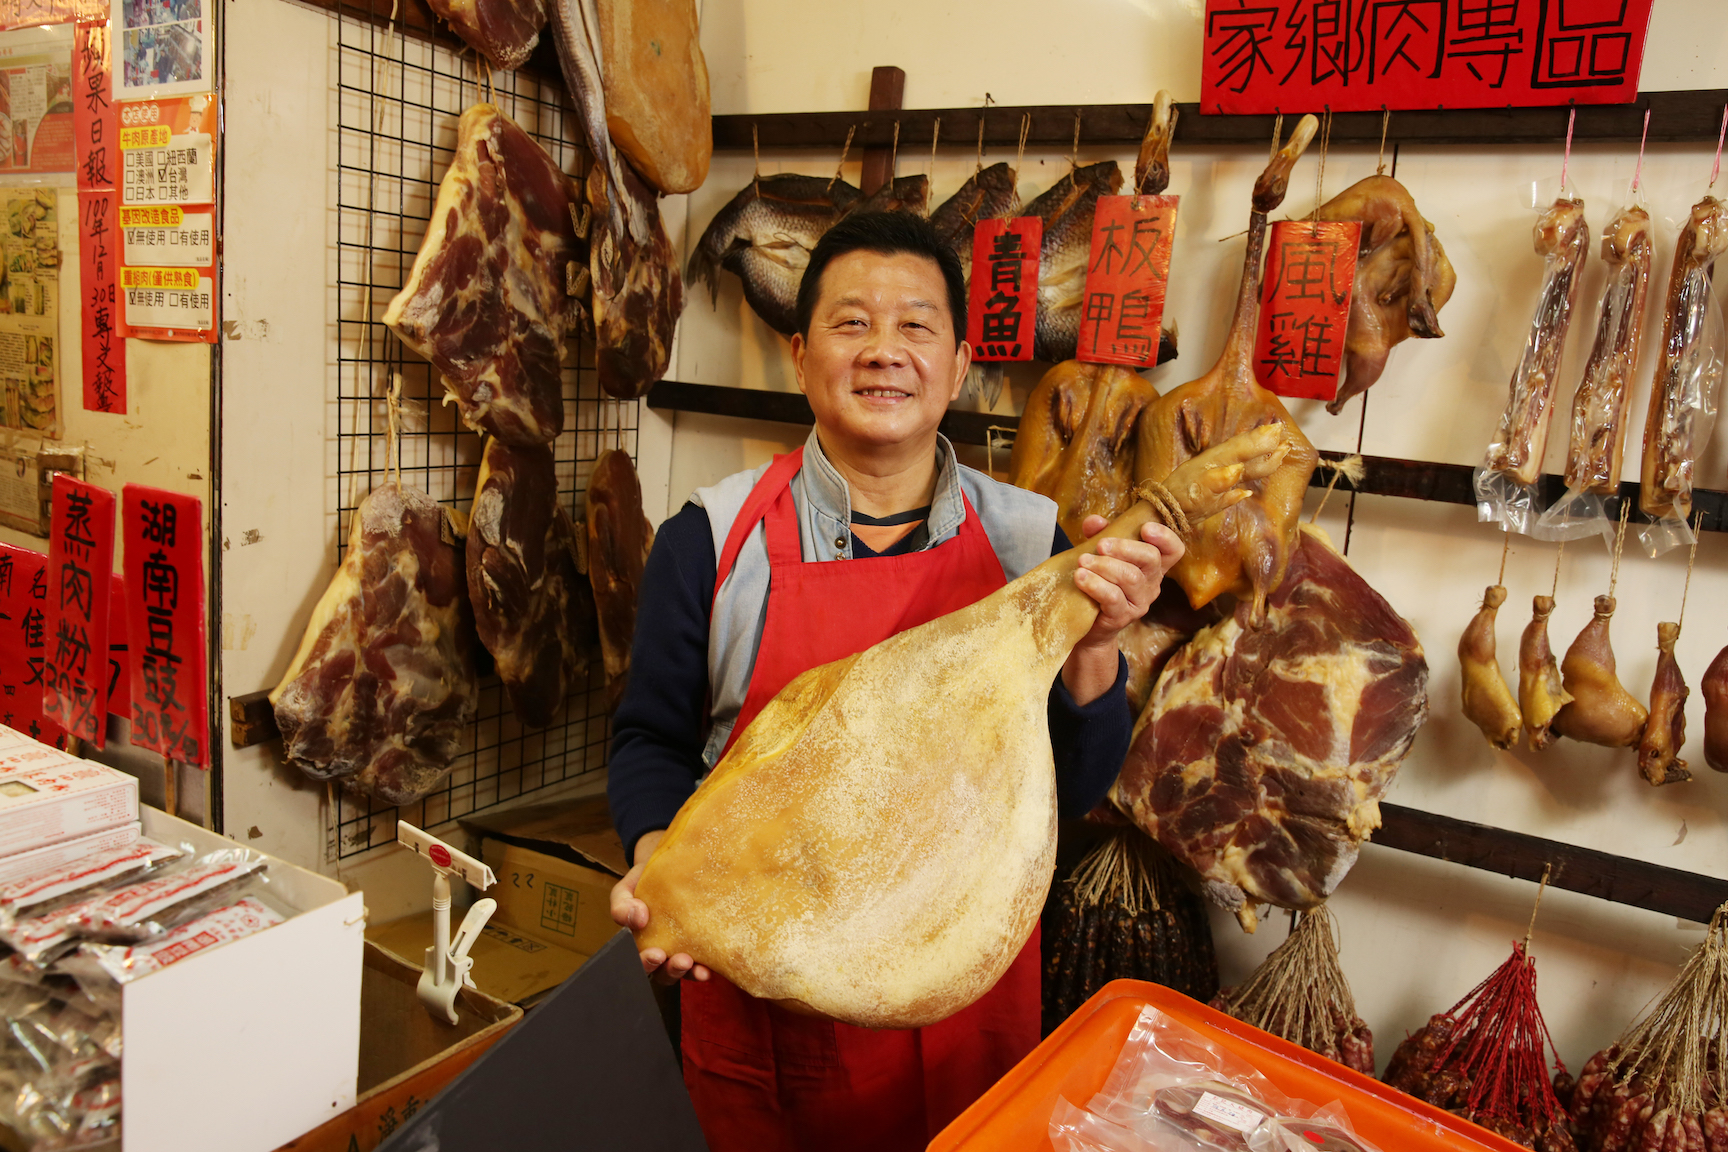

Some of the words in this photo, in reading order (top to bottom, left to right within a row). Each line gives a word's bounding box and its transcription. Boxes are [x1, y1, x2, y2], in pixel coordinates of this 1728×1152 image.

[1208, 0, 1631, 93] 家鄉肉專區
[122, 128, 168, 147] 牛肉原產地
[135, 151, 154, 167] 美國
[167, 148, 197, 166] 紐西蘭
[135, 168, 155, 185] 澳洲
[168, 166, 188, 184] 台灣
[136, 186, 155, 201] 日本
[168, 184, 189, 200] 其他
[121, 208, 180, 225] 基因改造食品
[135, 229, 166, 246] 無使用
[179, 229, 209, 246] 有使用
[975, 230, 1027, 358] 青魚
[1086, 216, 1164, 363] 板鴨
[137, 291, 164, 307] 無使用
[179, 292, 209, 310] 有使用
[1260, 241, 1347, 379] 風雞
[55, 488, 96, 677] 蒸肉粉
[140, 498, 186, 712] 湖南豆豉
